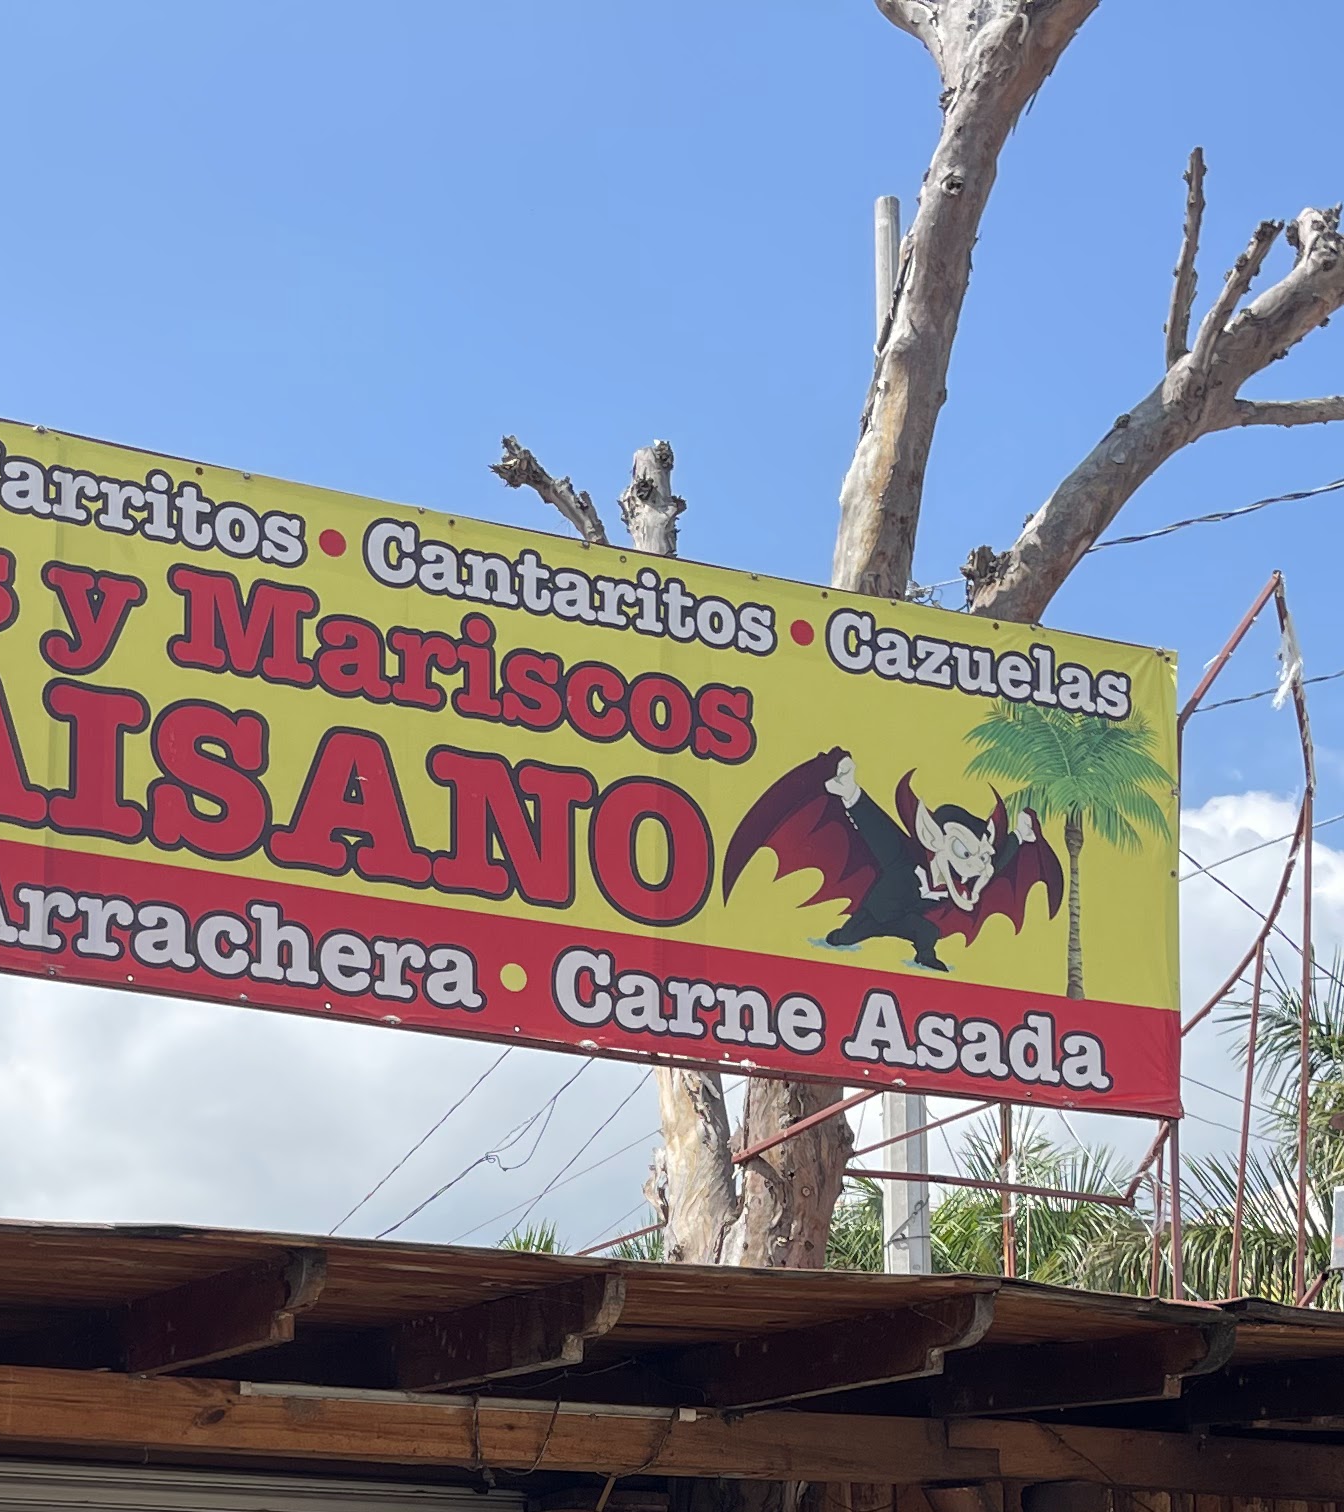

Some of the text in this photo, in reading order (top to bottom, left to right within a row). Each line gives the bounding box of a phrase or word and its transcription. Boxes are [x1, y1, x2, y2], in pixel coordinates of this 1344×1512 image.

[42, 561, 147, 675] y
[166, 563, 756, 764] Mariscos
[364, 518, 776, 655] Cantaritos
[825, 607, 1132, 721] Cazuelas
[552, 945, 826, 1057] Carne
[843, 989, 1113, 1095] Asada
